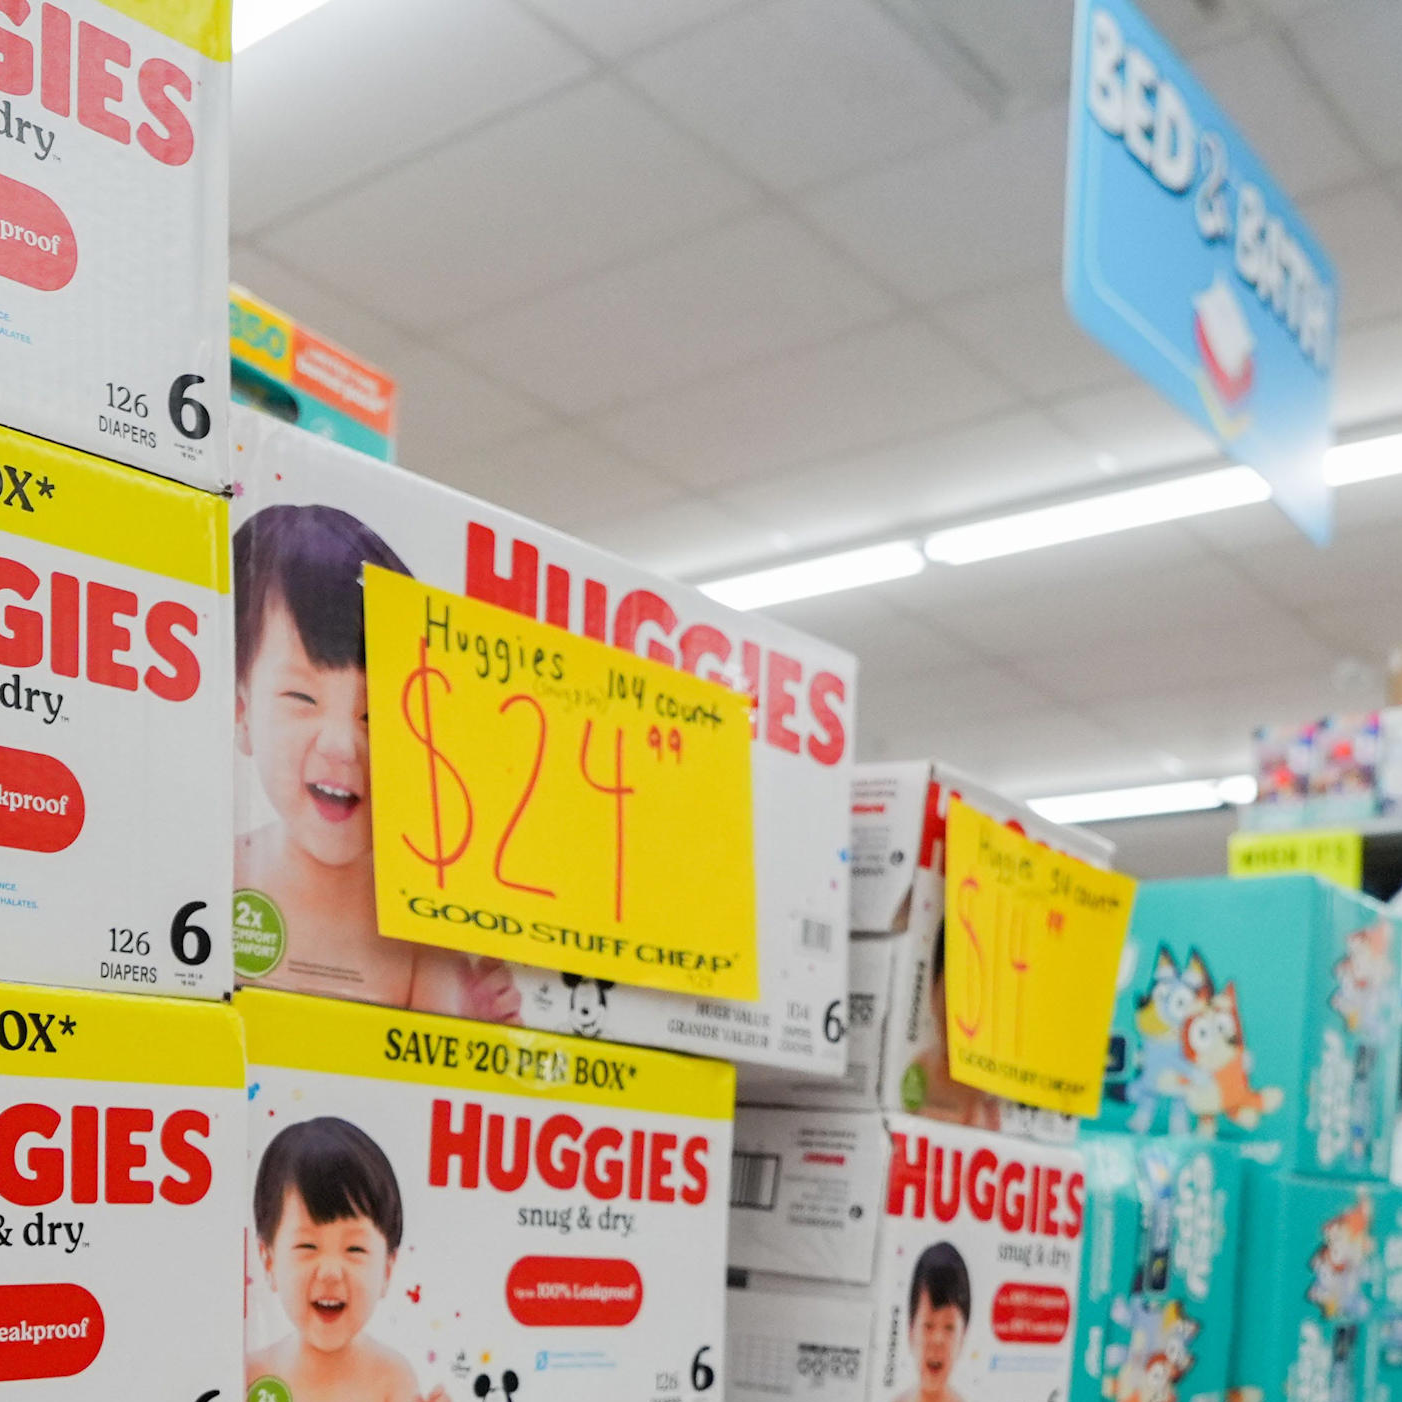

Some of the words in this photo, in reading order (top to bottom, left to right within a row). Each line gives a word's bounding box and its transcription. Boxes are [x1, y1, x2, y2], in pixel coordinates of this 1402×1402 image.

[1089, 8, 1196, 196] BED
[105, 382, 149, 419] 126
[168, 373, 211, 441] 6
[99, 415, 157, 449] DIAPERS
[425, 597, 566, 685] Huggies
[607, 668, 646, 709] 104
[655, 691, 724, 729] count
[109, 928, 150, 956] 126
[170, 901, 212, 966] 6
[529, 922, 630, 959] STUFF
[100, 962, 157, 984] DIAPERS
[822, 1000, 846, 1046] 6
[384, 1028, 460, 1069] SAVE
[466, 1042, 509, 1075] $20
[517, 1048, 567, 1083] PER
[428, 1099, 709, 1206] HUGGIES
[885, 1131, 1086, 1239] HUGGIES
[691, 1345, 714, 1393] 6
